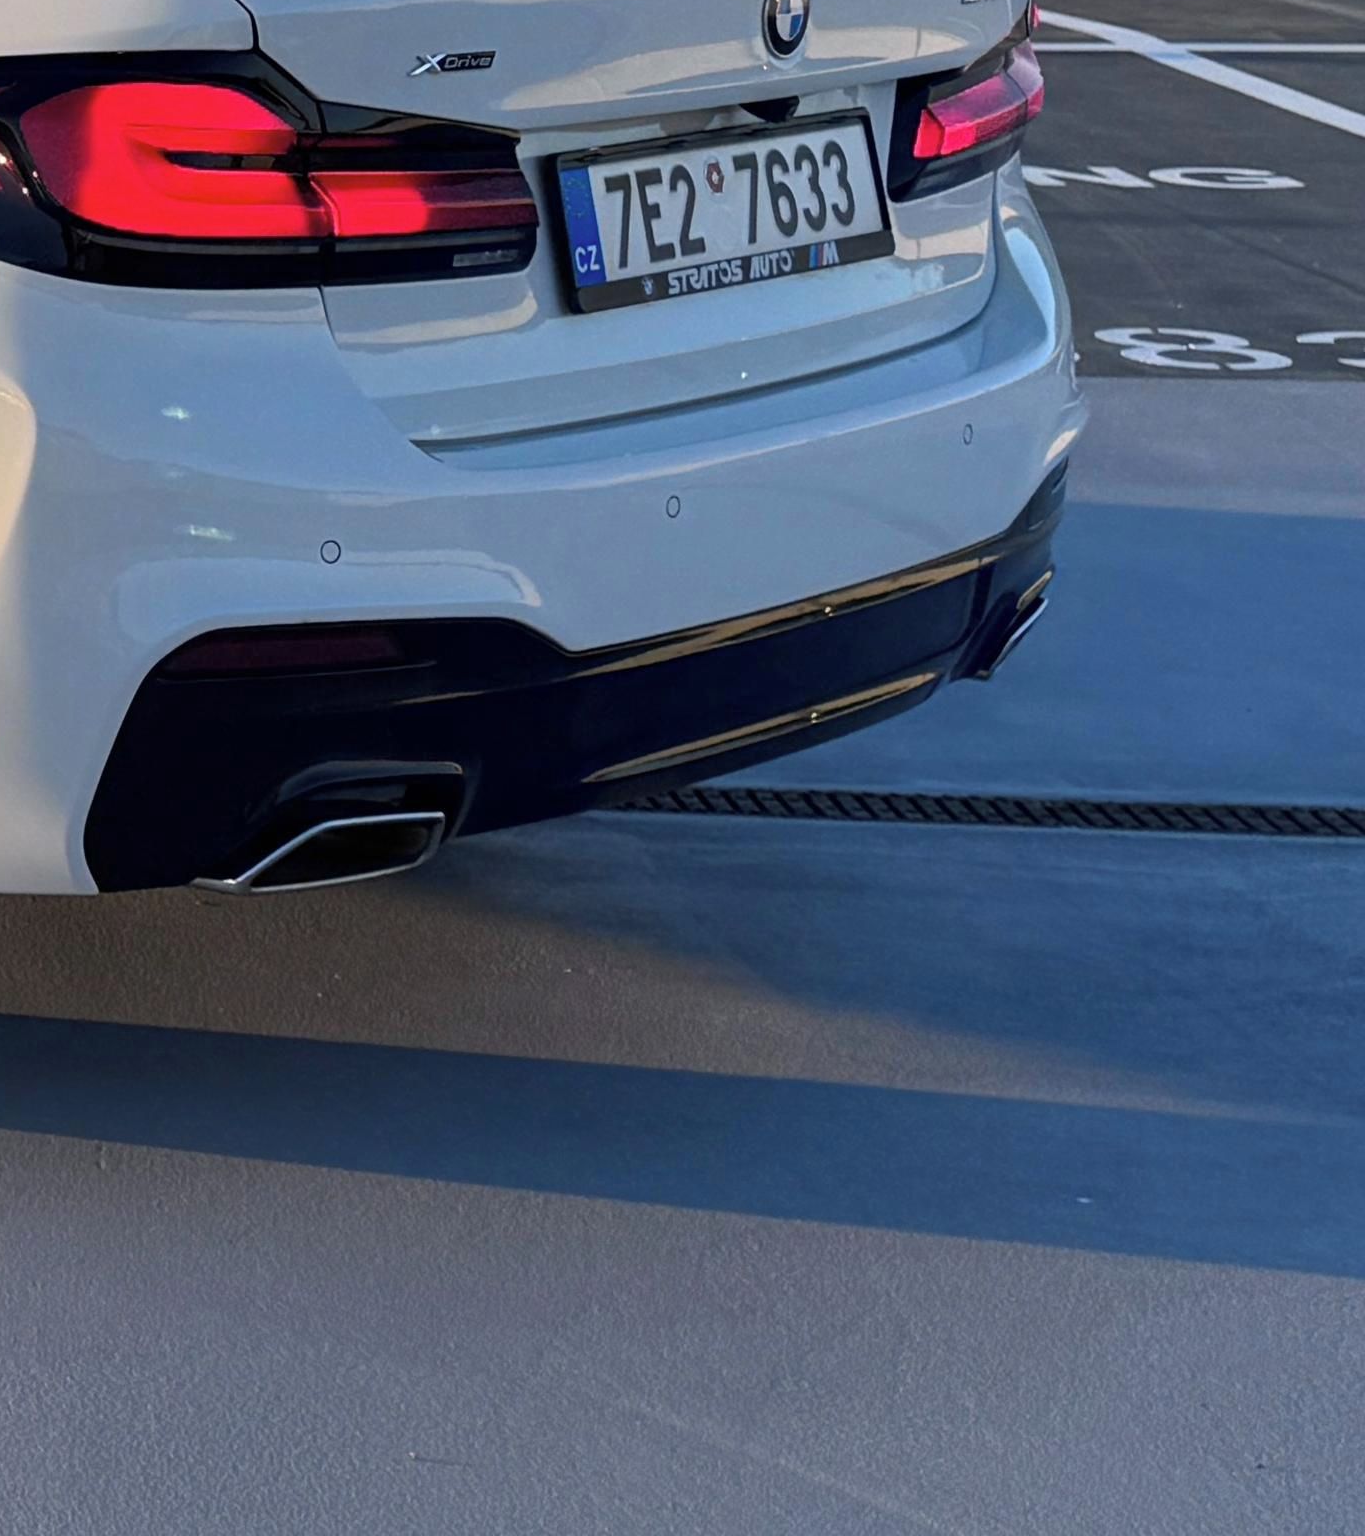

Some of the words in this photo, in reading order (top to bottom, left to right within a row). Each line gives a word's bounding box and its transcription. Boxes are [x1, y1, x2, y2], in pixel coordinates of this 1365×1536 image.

[603, 164, 707, 270] 7E2
[732, 139, 856, 245] 7633
[574, 244, 601, 273] CZ
[667, 259, 743, 296] STRATOS
[749, 250, 793, 281] AUTO
